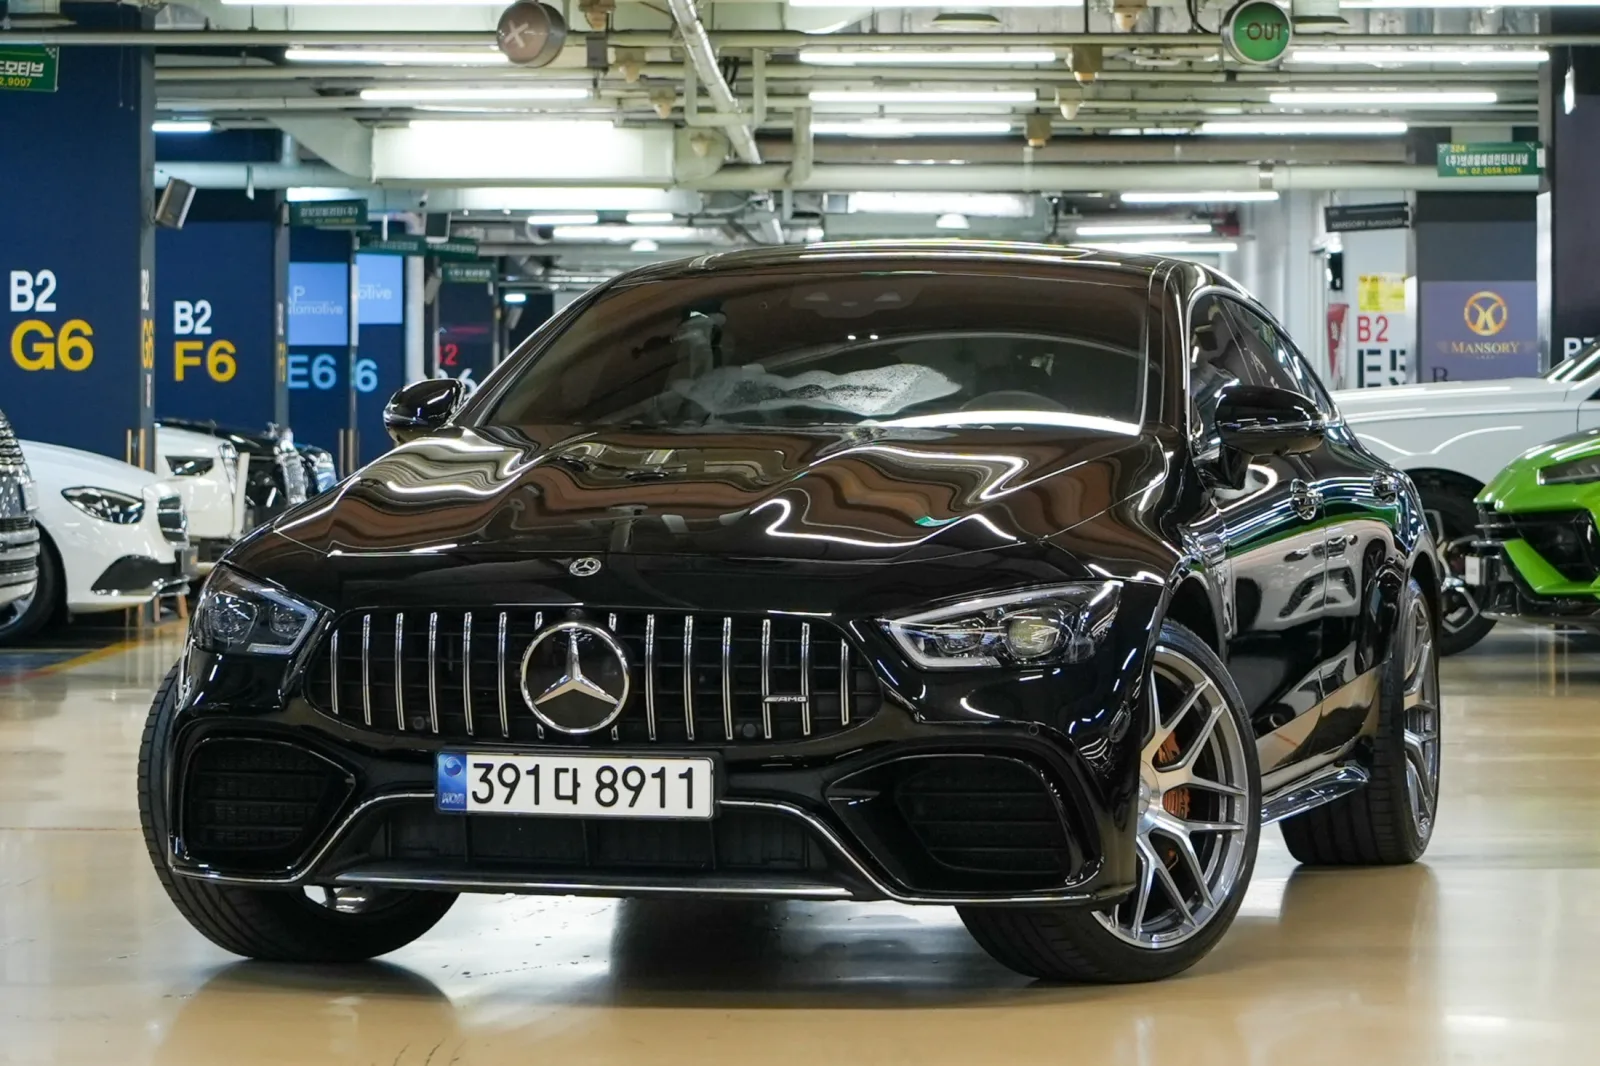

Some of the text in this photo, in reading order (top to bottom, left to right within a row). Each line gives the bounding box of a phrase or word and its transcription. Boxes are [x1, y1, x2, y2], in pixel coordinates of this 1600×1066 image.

[1247, 22, 1282, 41] OUT
[10, 269, 57, 312] B2
[174, 299, 212, 335] B2
[1357, 315, 1389, 342] B2
[10, 319, 94, 371] G6
[174, 339, 236, 382] F6
[1451, 341, 1520, 355] MANSORY
[288, 353, 337, 390] E6
[595, 765, 694, 809] 8911
